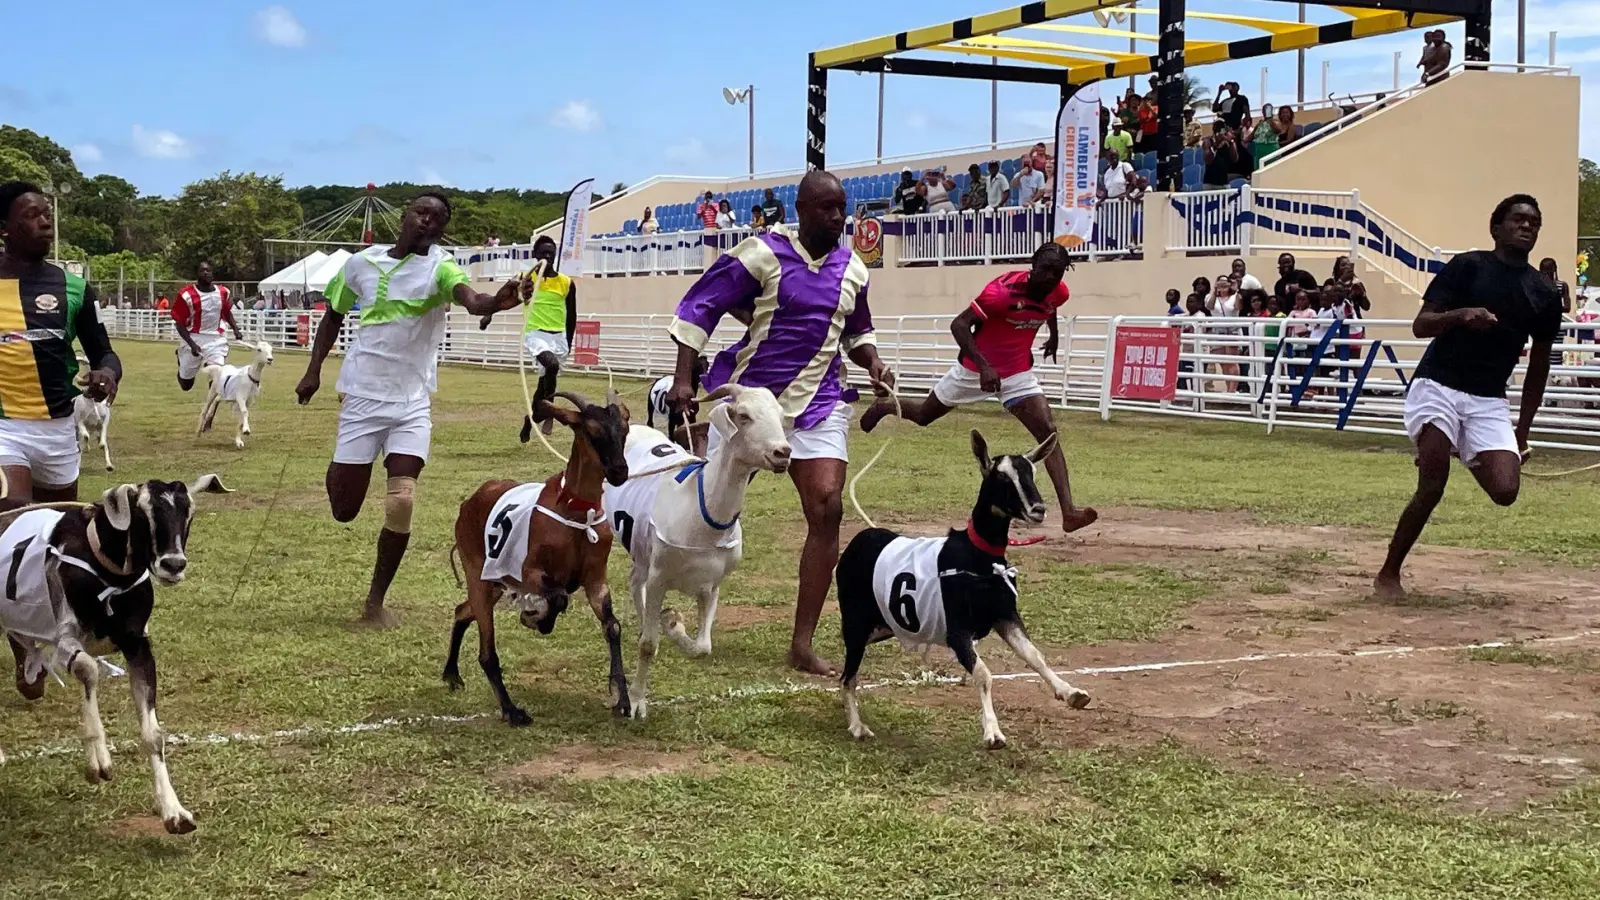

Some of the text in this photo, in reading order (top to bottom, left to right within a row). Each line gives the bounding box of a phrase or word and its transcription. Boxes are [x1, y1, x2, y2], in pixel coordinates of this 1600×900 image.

[1064, 126, 1076, 208] CREDIT UNION
[1076, 126, 1089, 190] LAMBEAU
[1132, 366, 1141, 386] TO
[488, 503, 520, 559] 5
[6, 534, 37, 601] 1
[888, 572, 921, 634] 6
